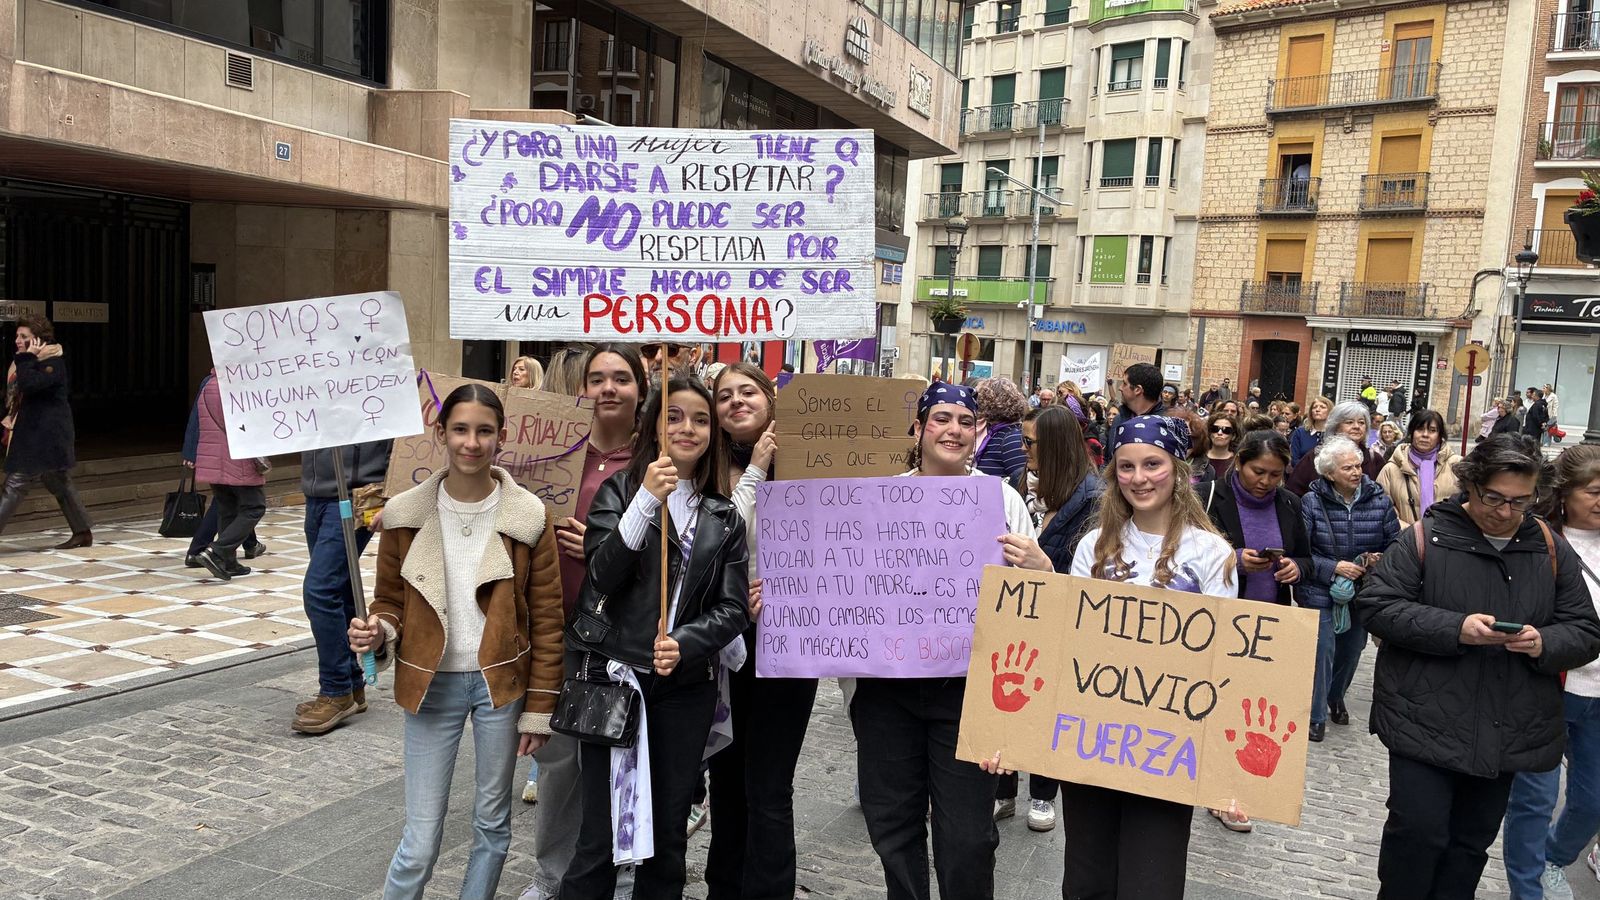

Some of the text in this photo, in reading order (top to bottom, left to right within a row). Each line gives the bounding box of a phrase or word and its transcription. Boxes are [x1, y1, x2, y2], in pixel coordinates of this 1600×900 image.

[279, 147, 288, 156] 27
[575, 134, 618, 161] UNA
[628, 134, 731, 163] mujer
[751, 134, 819, 162] TIENE
[835, 137, 860, 166] Q
[540, 161, 640, 193] DARSE
[649, 164, 670, 193] A
[682, 163, 815, 191] RESPETAR
[480, 194, 806, 252] ¿PORQ NO PUEDE SER
[640, 232, 839, 262] RESPETADA POR
[474, 266, 512, 294] EL
[532, 266, 627, 297] SIMPLE
[651, 269, 732, 291] HECHO
[749, 269, 787, 290] DE
[801, 268, 855, 295] SER
[495, 293, 794, 336] una PERSONA?
[1534, 305, 1564, 313] Tentación
[223, 302, 339, 354] SOMOS
[1037, 320, 1086, 333] ABANCA
[1351, 333, 1413, 344] LA MARIMORENA
[225, 346, 399, 384] MUJERES Y CON
[230, 374, 408, 415] NINGUNA PUEDEN
[866, 397, 886, 412] EL
[272, 408, 319, 439] 8M
[801, 422, 892, 440] GRITO DE
[806, 450, 833, 468] LAS
[846, 451, 877, 467] QUE
[784, 485, 806, 507] ES
[820, 484, 863, 507] QUE
[878, 484, 924, 504] TODO
[938, 486, 979, 506] SON
[761, 518, 966, 542] RISAS HAS HASTA QUE
[762, 548, 975, 569] VIOLAN A TU HERMANA O
[762, 577, 808, 596] MATAN
[816, 575, 828, 594] A
[833, 575, 854, 595] TU
[864, 573, 927, 596] MADRE...
[934, 577, 956, 598] ES
[762, 605, 820, 628] CUANDO
[828, 607, 885, 626] CAMBIAS
[898, 607, 924, 626] LOS
[995, 579, 1280, 662] MI MIEDO SE
[762, 633, 972, 661] POR IMÁGENES SE BUSCA
[1073, 657, 1231, 722] VOLVIÓ
[1051, 713, 1198, 781] FUERZA
